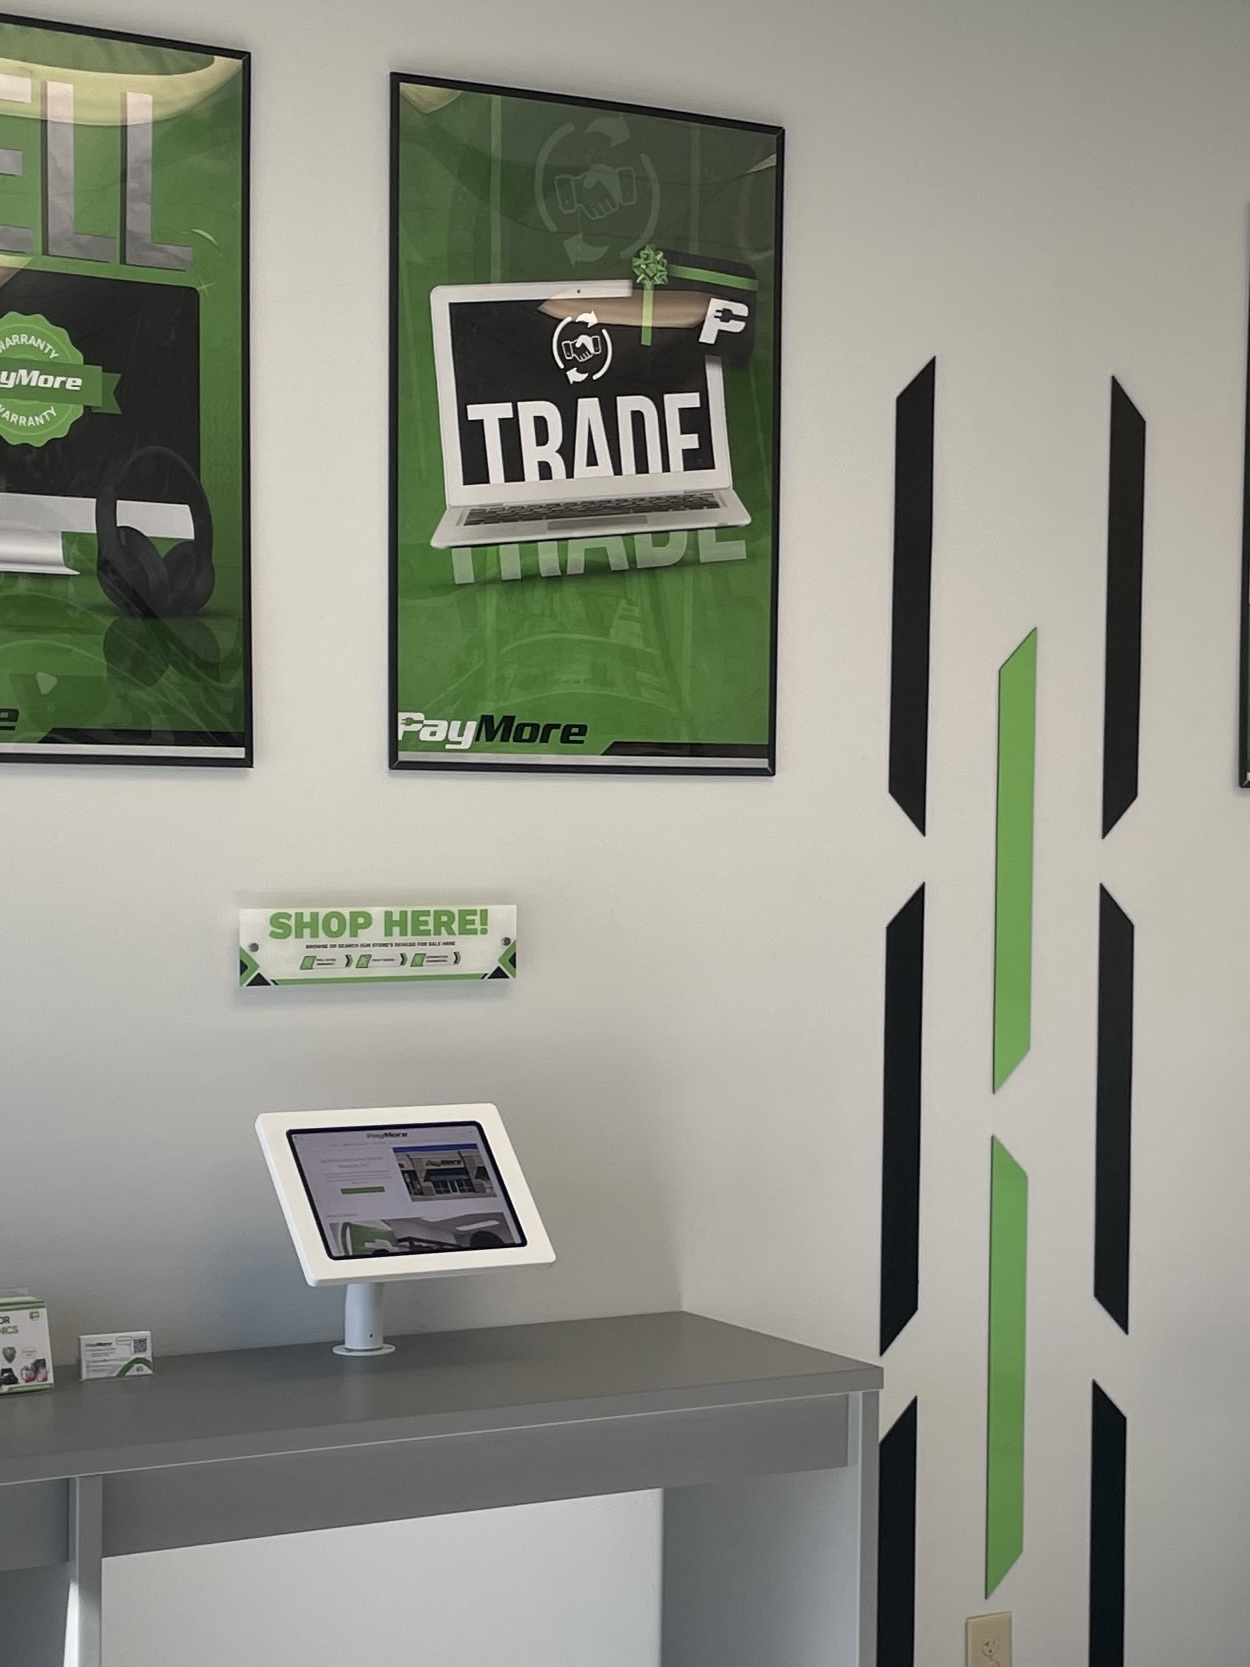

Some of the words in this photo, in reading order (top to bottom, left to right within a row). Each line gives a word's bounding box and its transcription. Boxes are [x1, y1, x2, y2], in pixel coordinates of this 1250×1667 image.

[397, 711, 588, 750] PayMore
[269, 911, 373, 940] SHOP
[384, 908, 489, 937] HERE!
